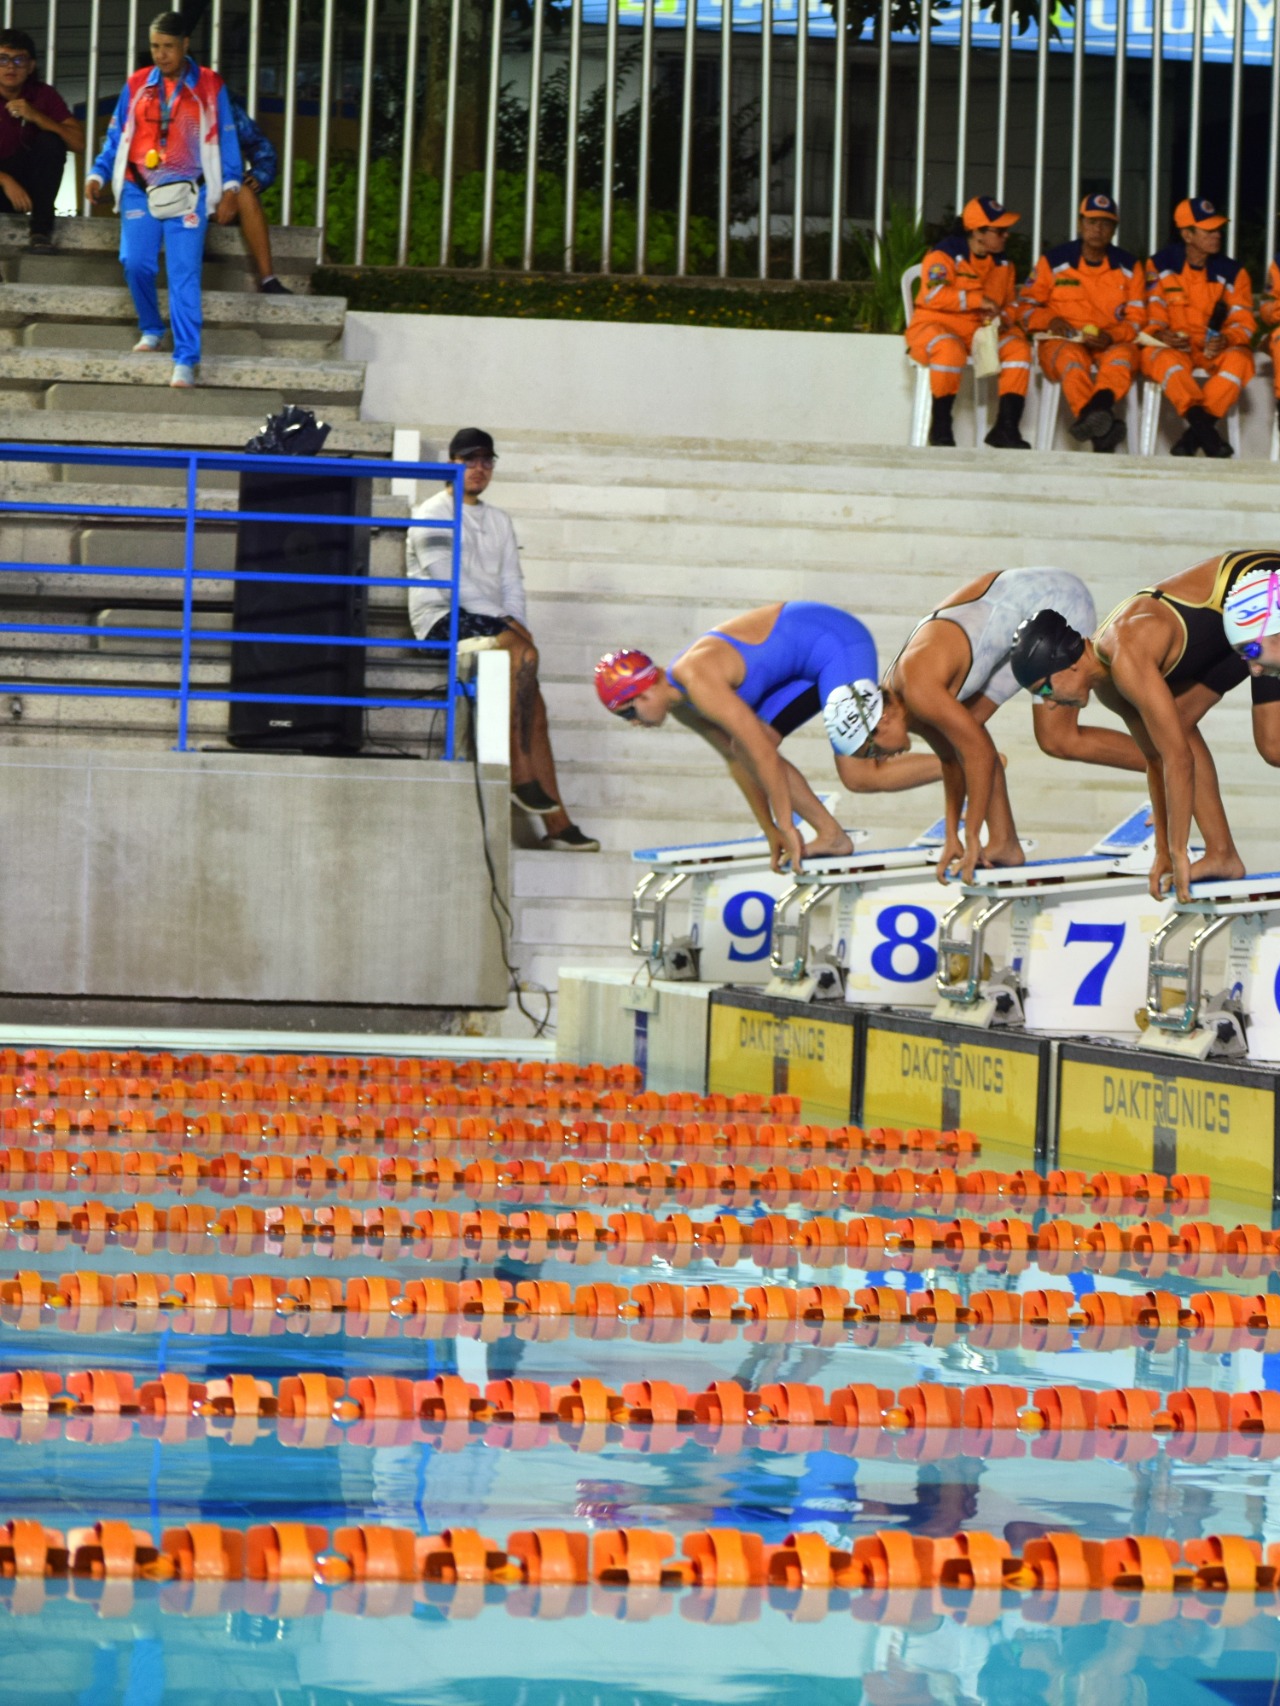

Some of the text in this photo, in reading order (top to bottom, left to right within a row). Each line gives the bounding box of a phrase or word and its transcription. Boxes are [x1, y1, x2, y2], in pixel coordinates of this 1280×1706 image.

[722, 890, 775, 962] 9
[870, 904, 938, 982] 8
[1063, 921, 1126, 1006] 7
[740, 1016, 825, 1061] DAKTRONICS
[901, 1043, 1003, 1093] DAKTRONICS
[1103, 1076, 1230, 1134] DAKTRONICS
